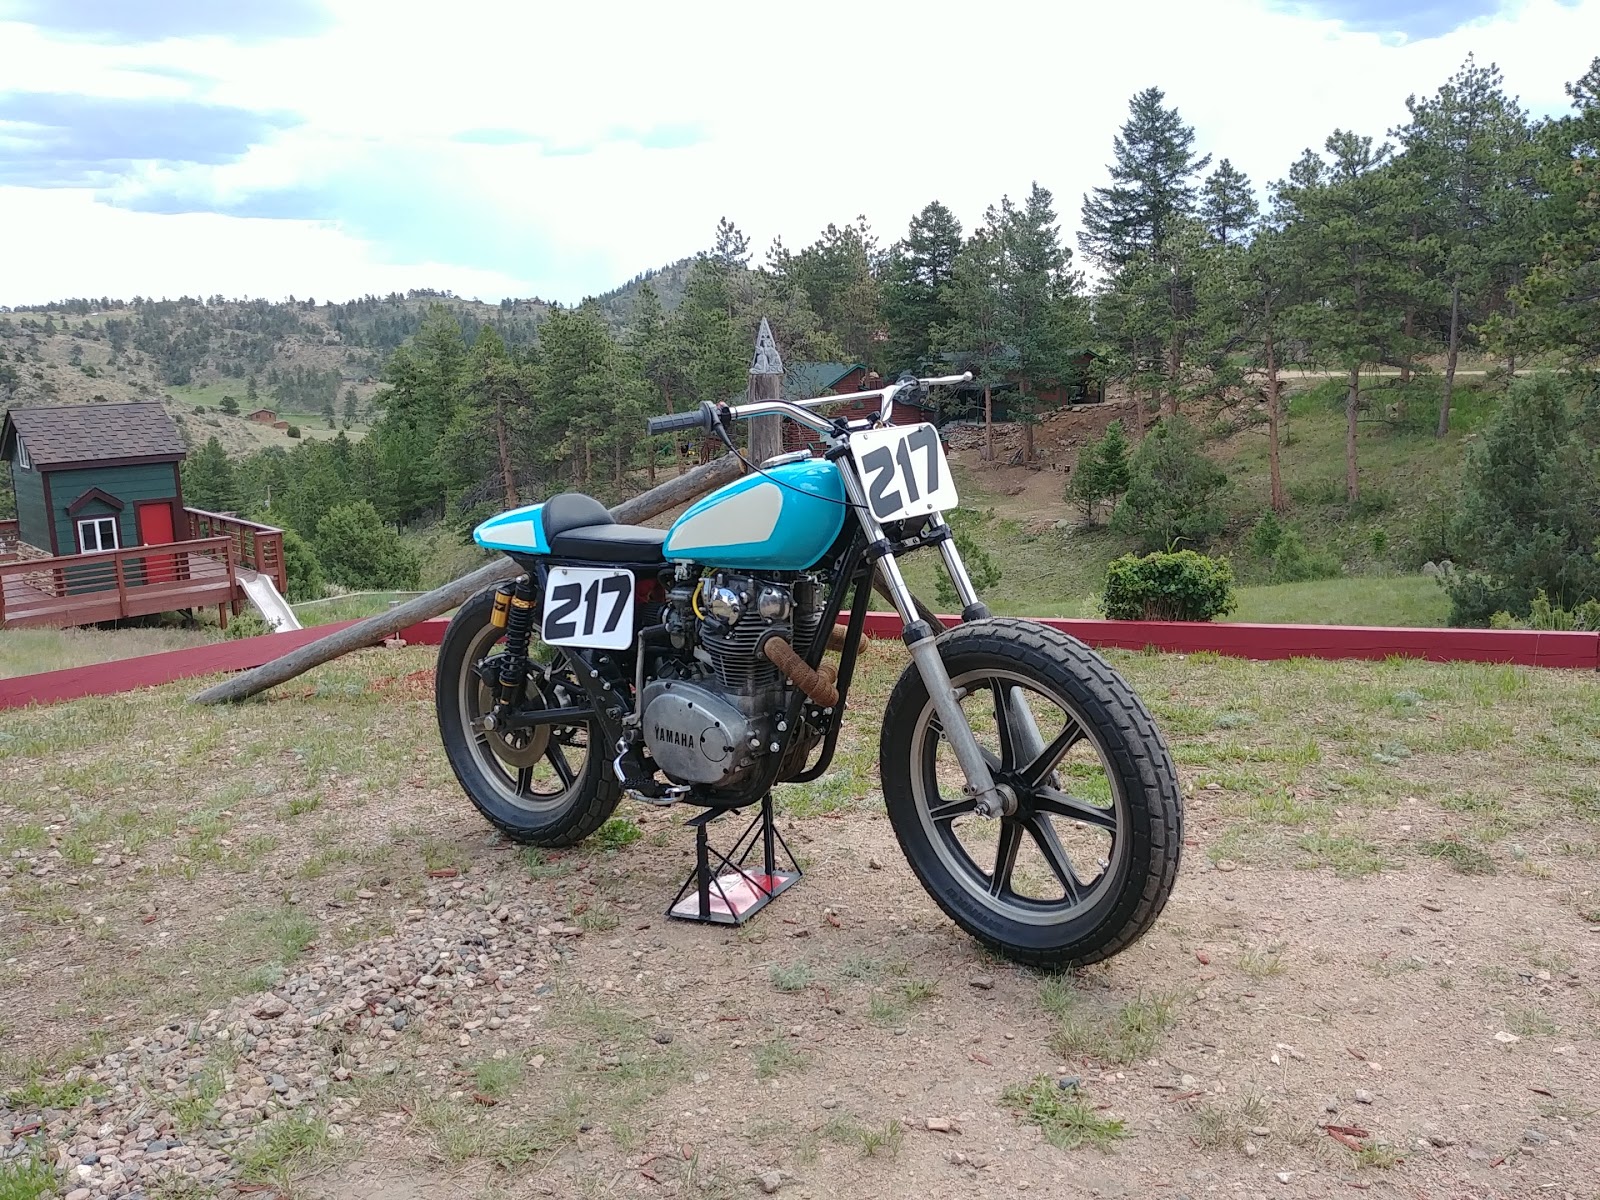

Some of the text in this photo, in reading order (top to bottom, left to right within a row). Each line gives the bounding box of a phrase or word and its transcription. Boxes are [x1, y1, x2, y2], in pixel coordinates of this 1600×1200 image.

[861, 425, 939, 518] 217
[544, 574, 632, 640] 217
[654, 725, 694, 749] YAMAHA
